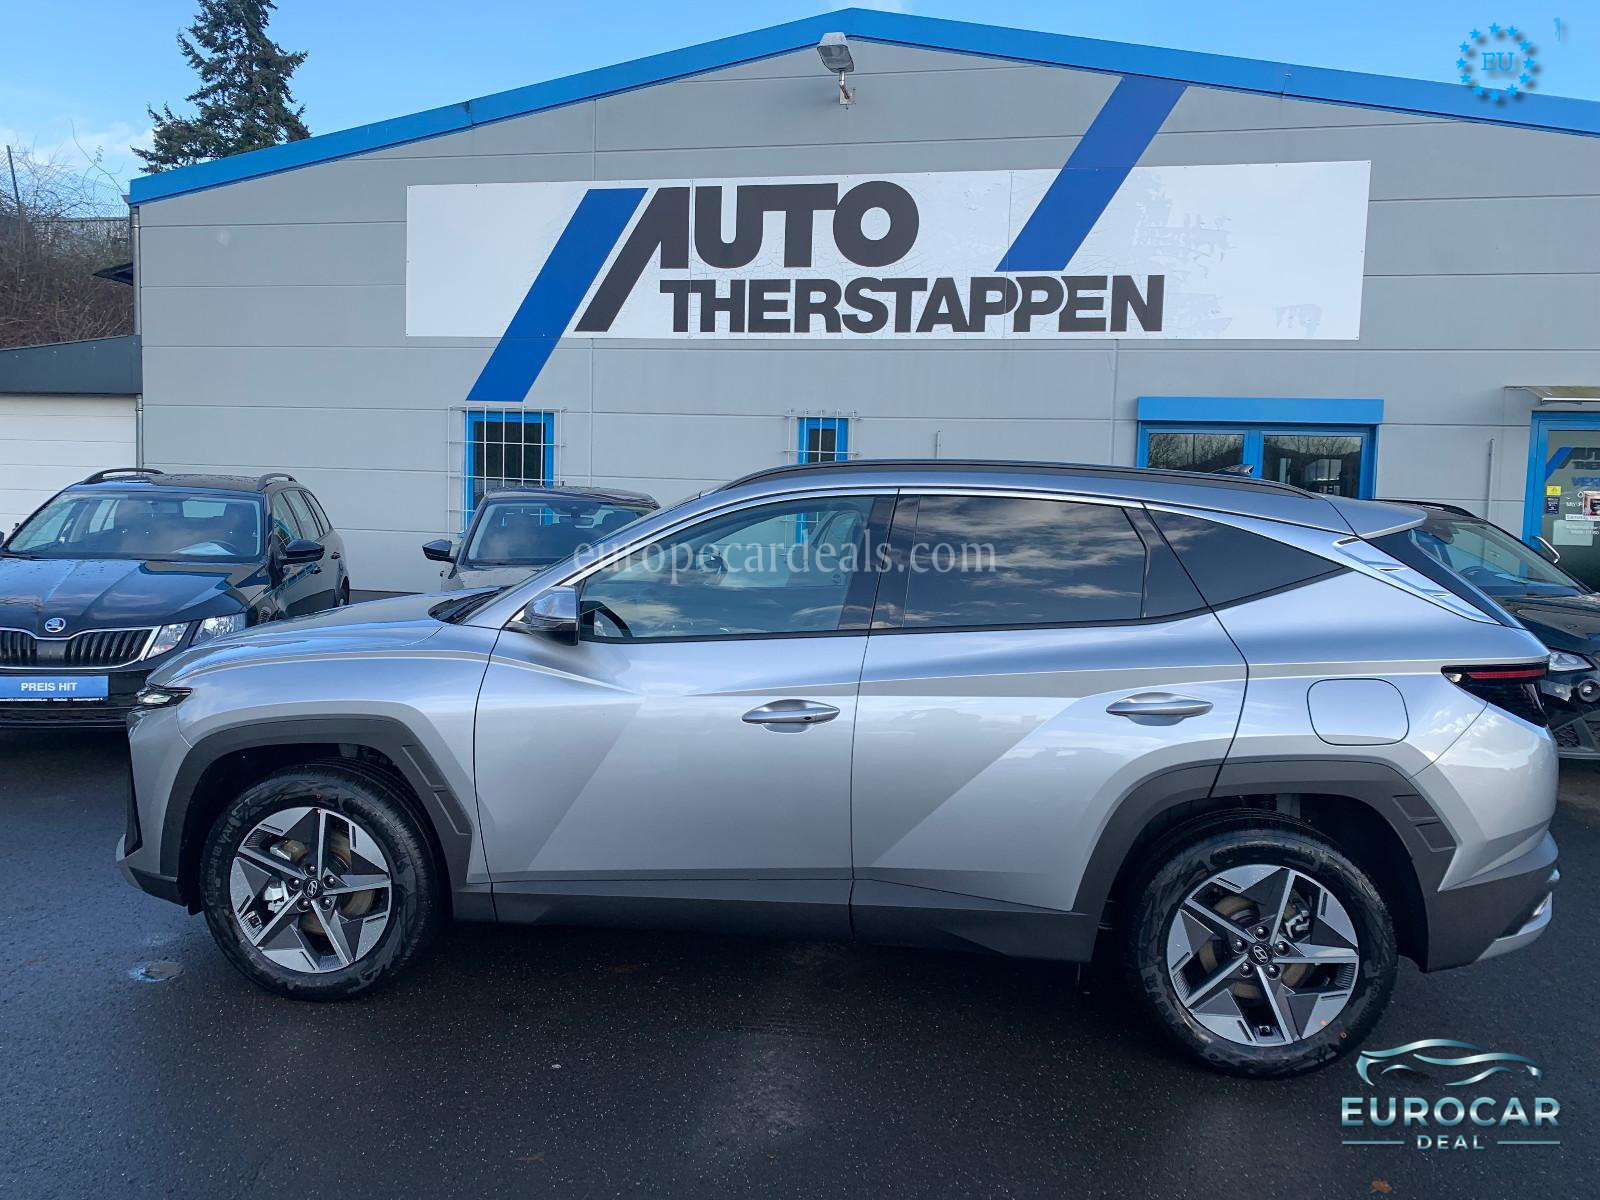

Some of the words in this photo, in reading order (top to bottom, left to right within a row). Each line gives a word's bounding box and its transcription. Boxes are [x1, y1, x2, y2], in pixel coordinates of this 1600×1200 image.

[574, 180, 920, 332] AUTO
[659, 275, 1165, 334] THERSTAPPEN
[20, 682, 56, 692] PREIS
[58, 682, 78, 692] HIT
